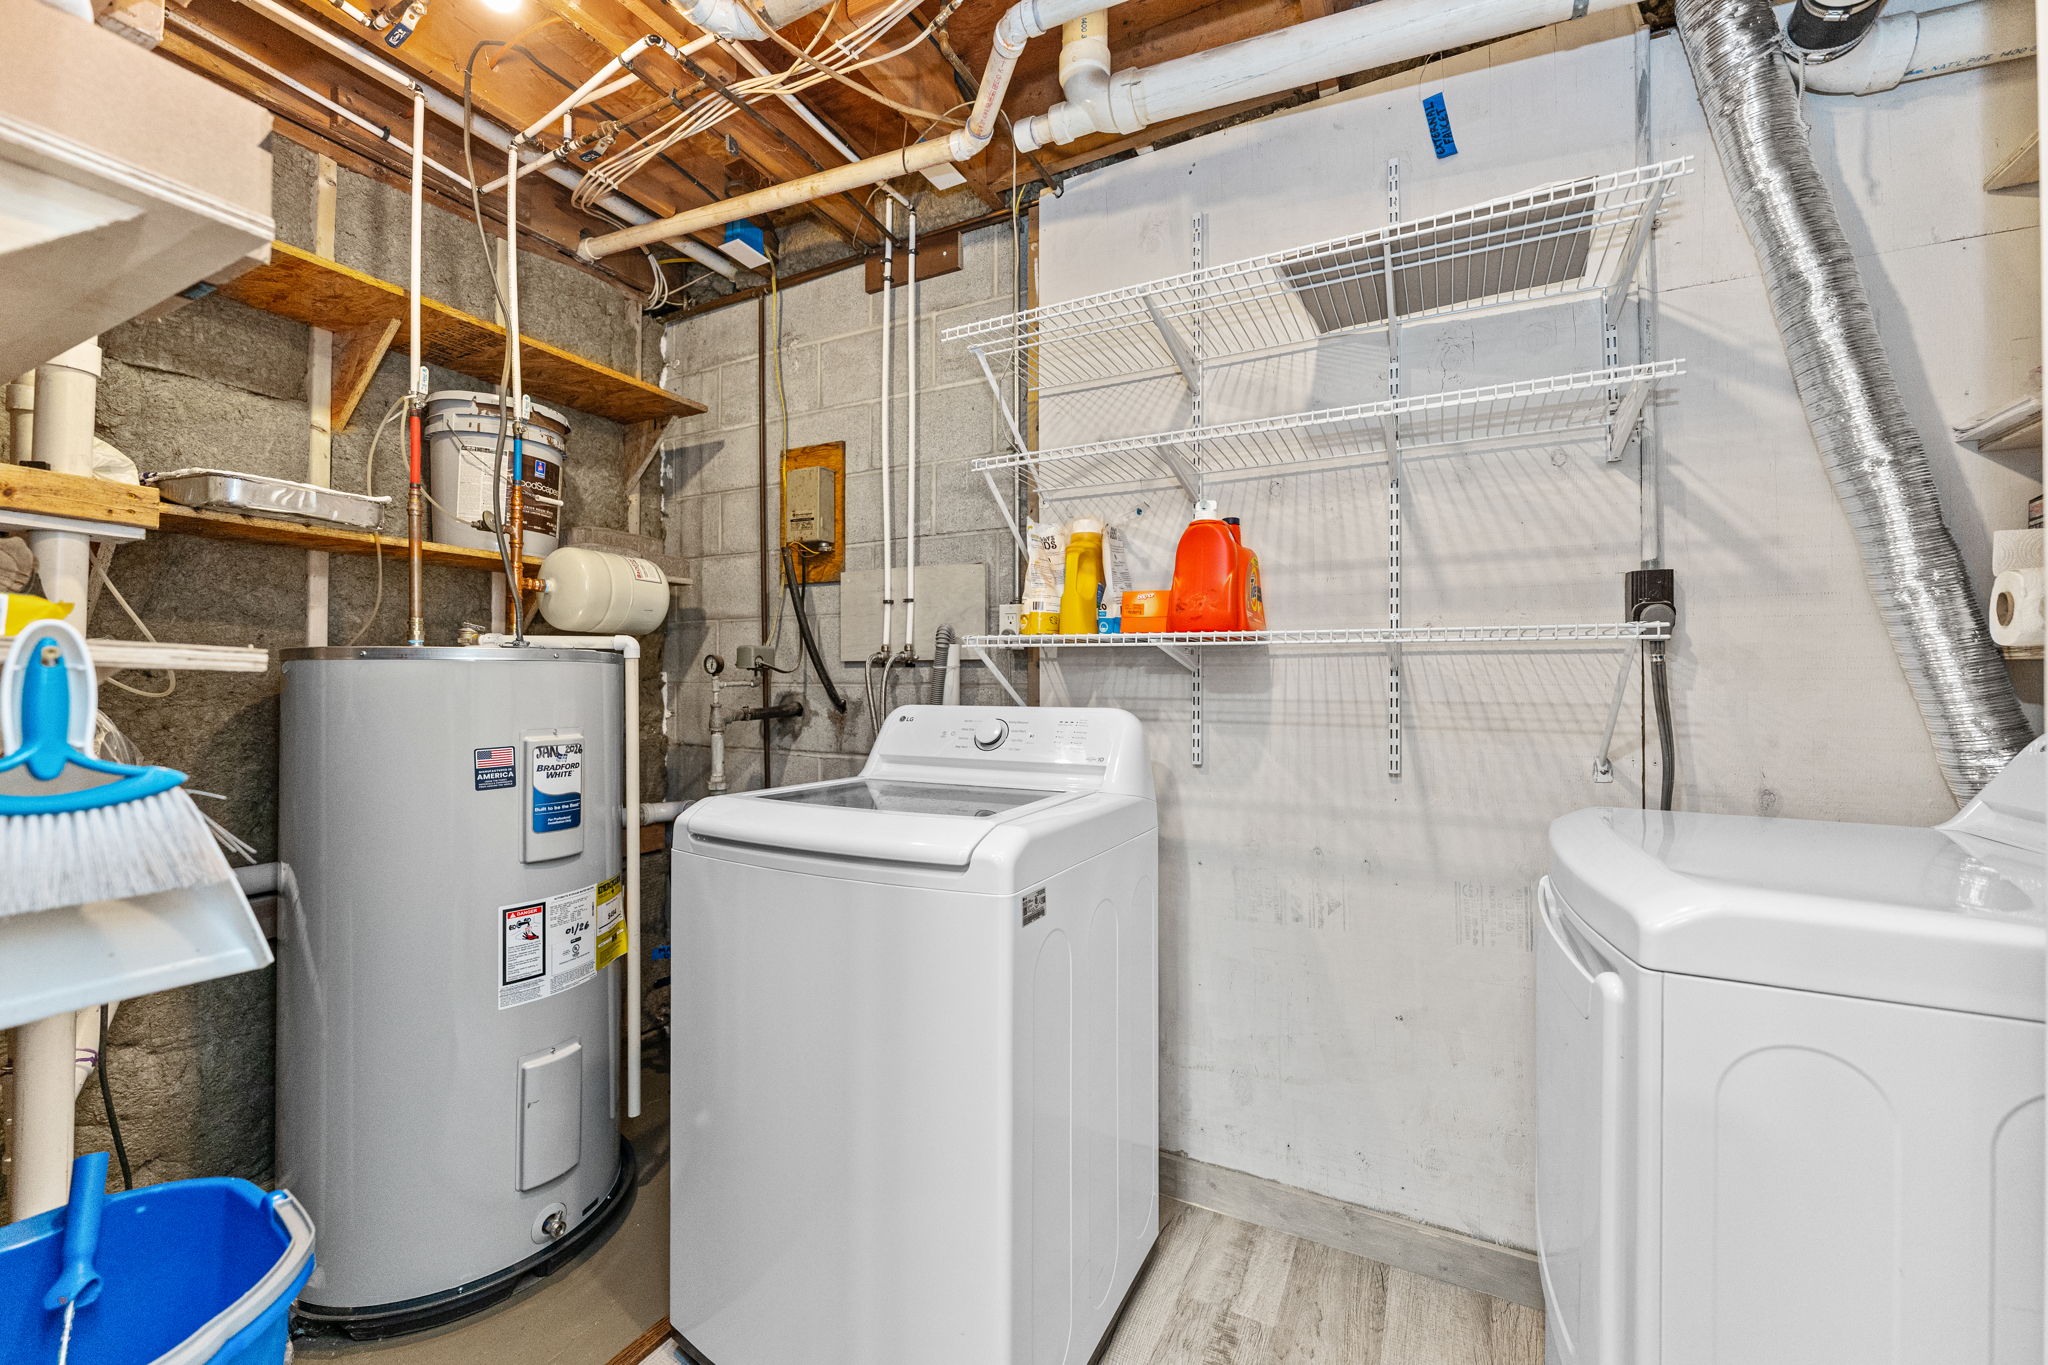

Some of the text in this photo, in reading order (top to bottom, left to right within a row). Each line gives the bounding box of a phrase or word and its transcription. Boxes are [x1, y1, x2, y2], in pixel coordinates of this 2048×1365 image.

[1932, 60, 1964, 72] NAT'L
[1967, 53, 1994, 64] PIPE
[1425, 102, 1446, 154] EXTERNAL
[1436, 108, 1454, 145] FAUCET
[536, 745, 559, 759] JAN
[536, 762, 580, 772] BRADFORD
[477, 771, 514, 780] AMERICA
[546, 770, 573, 779] WHITE
[565, 920, 590, 935] 01/26
